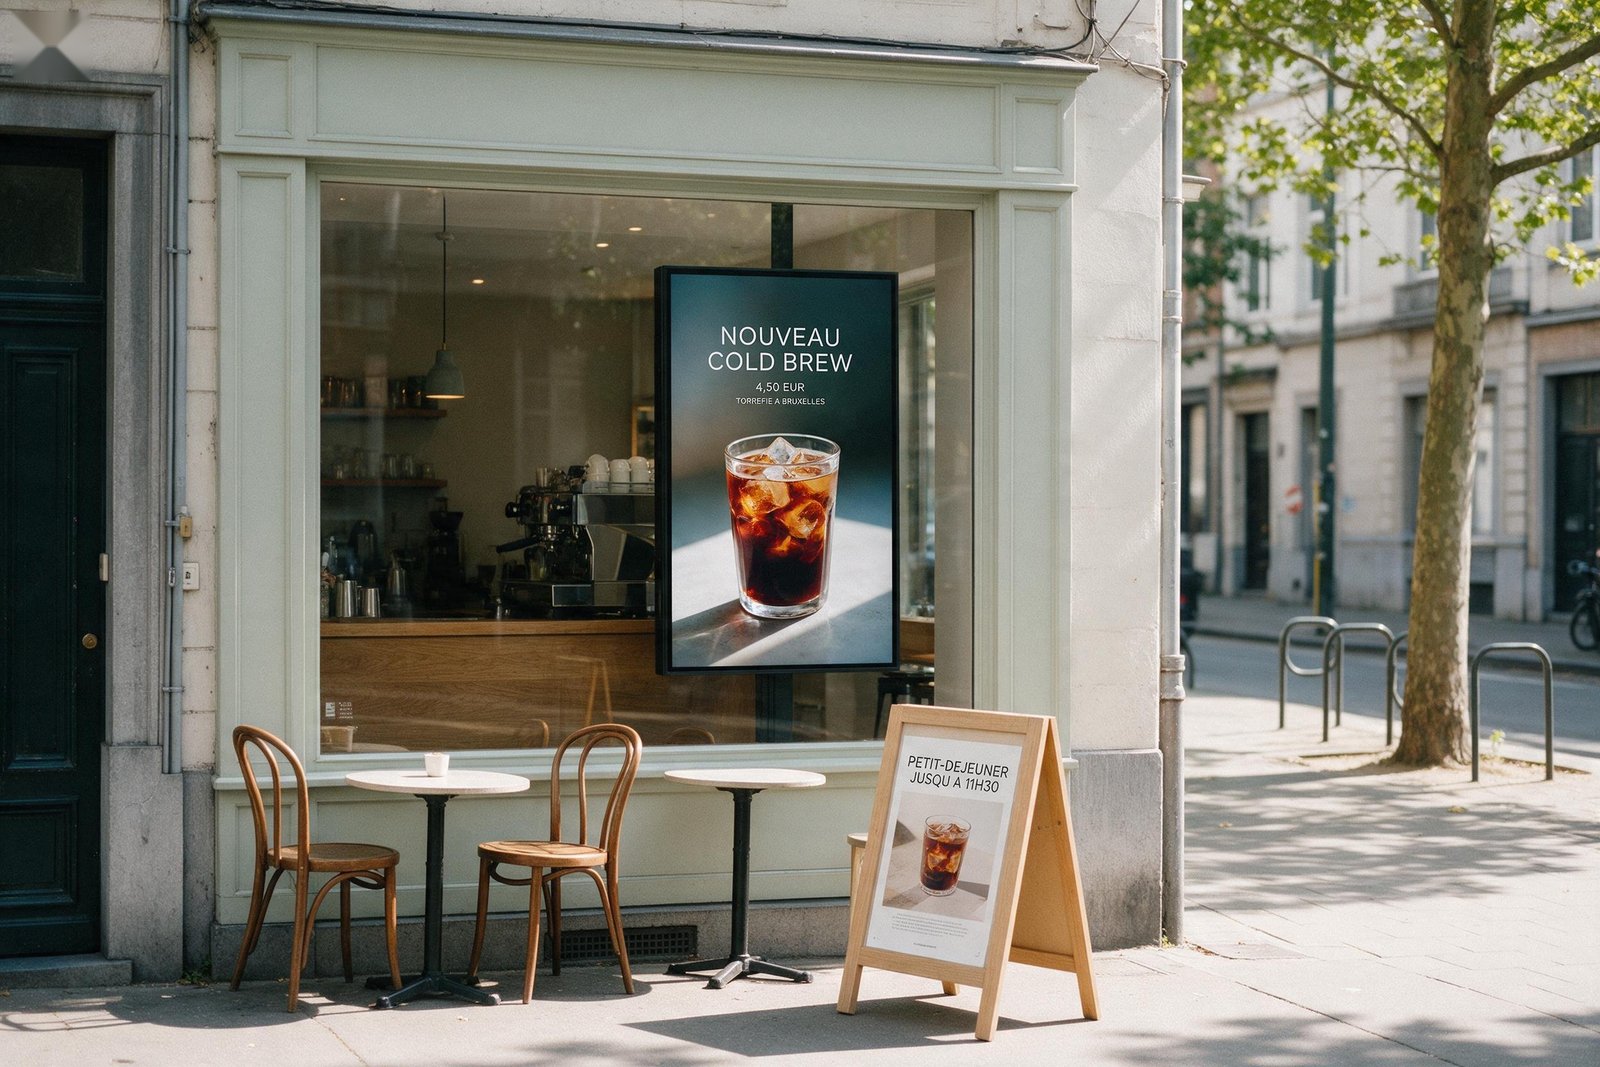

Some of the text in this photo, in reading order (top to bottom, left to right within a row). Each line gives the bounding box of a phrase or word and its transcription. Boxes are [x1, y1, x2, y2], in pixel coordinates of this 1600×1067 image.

[721, 326, 840, 347] NOUVEAU
[708, 351, 853, 373] COLD BREW
[755, 382, 805, 394] 4,50 EUR
[736, 397, 826, 405] TORREFIE A BRUXELLES
[907, 755, 1009, 778] PETIT-DEJEUNER
[909, 771, 1000, 793] JUSQU A 11H30
